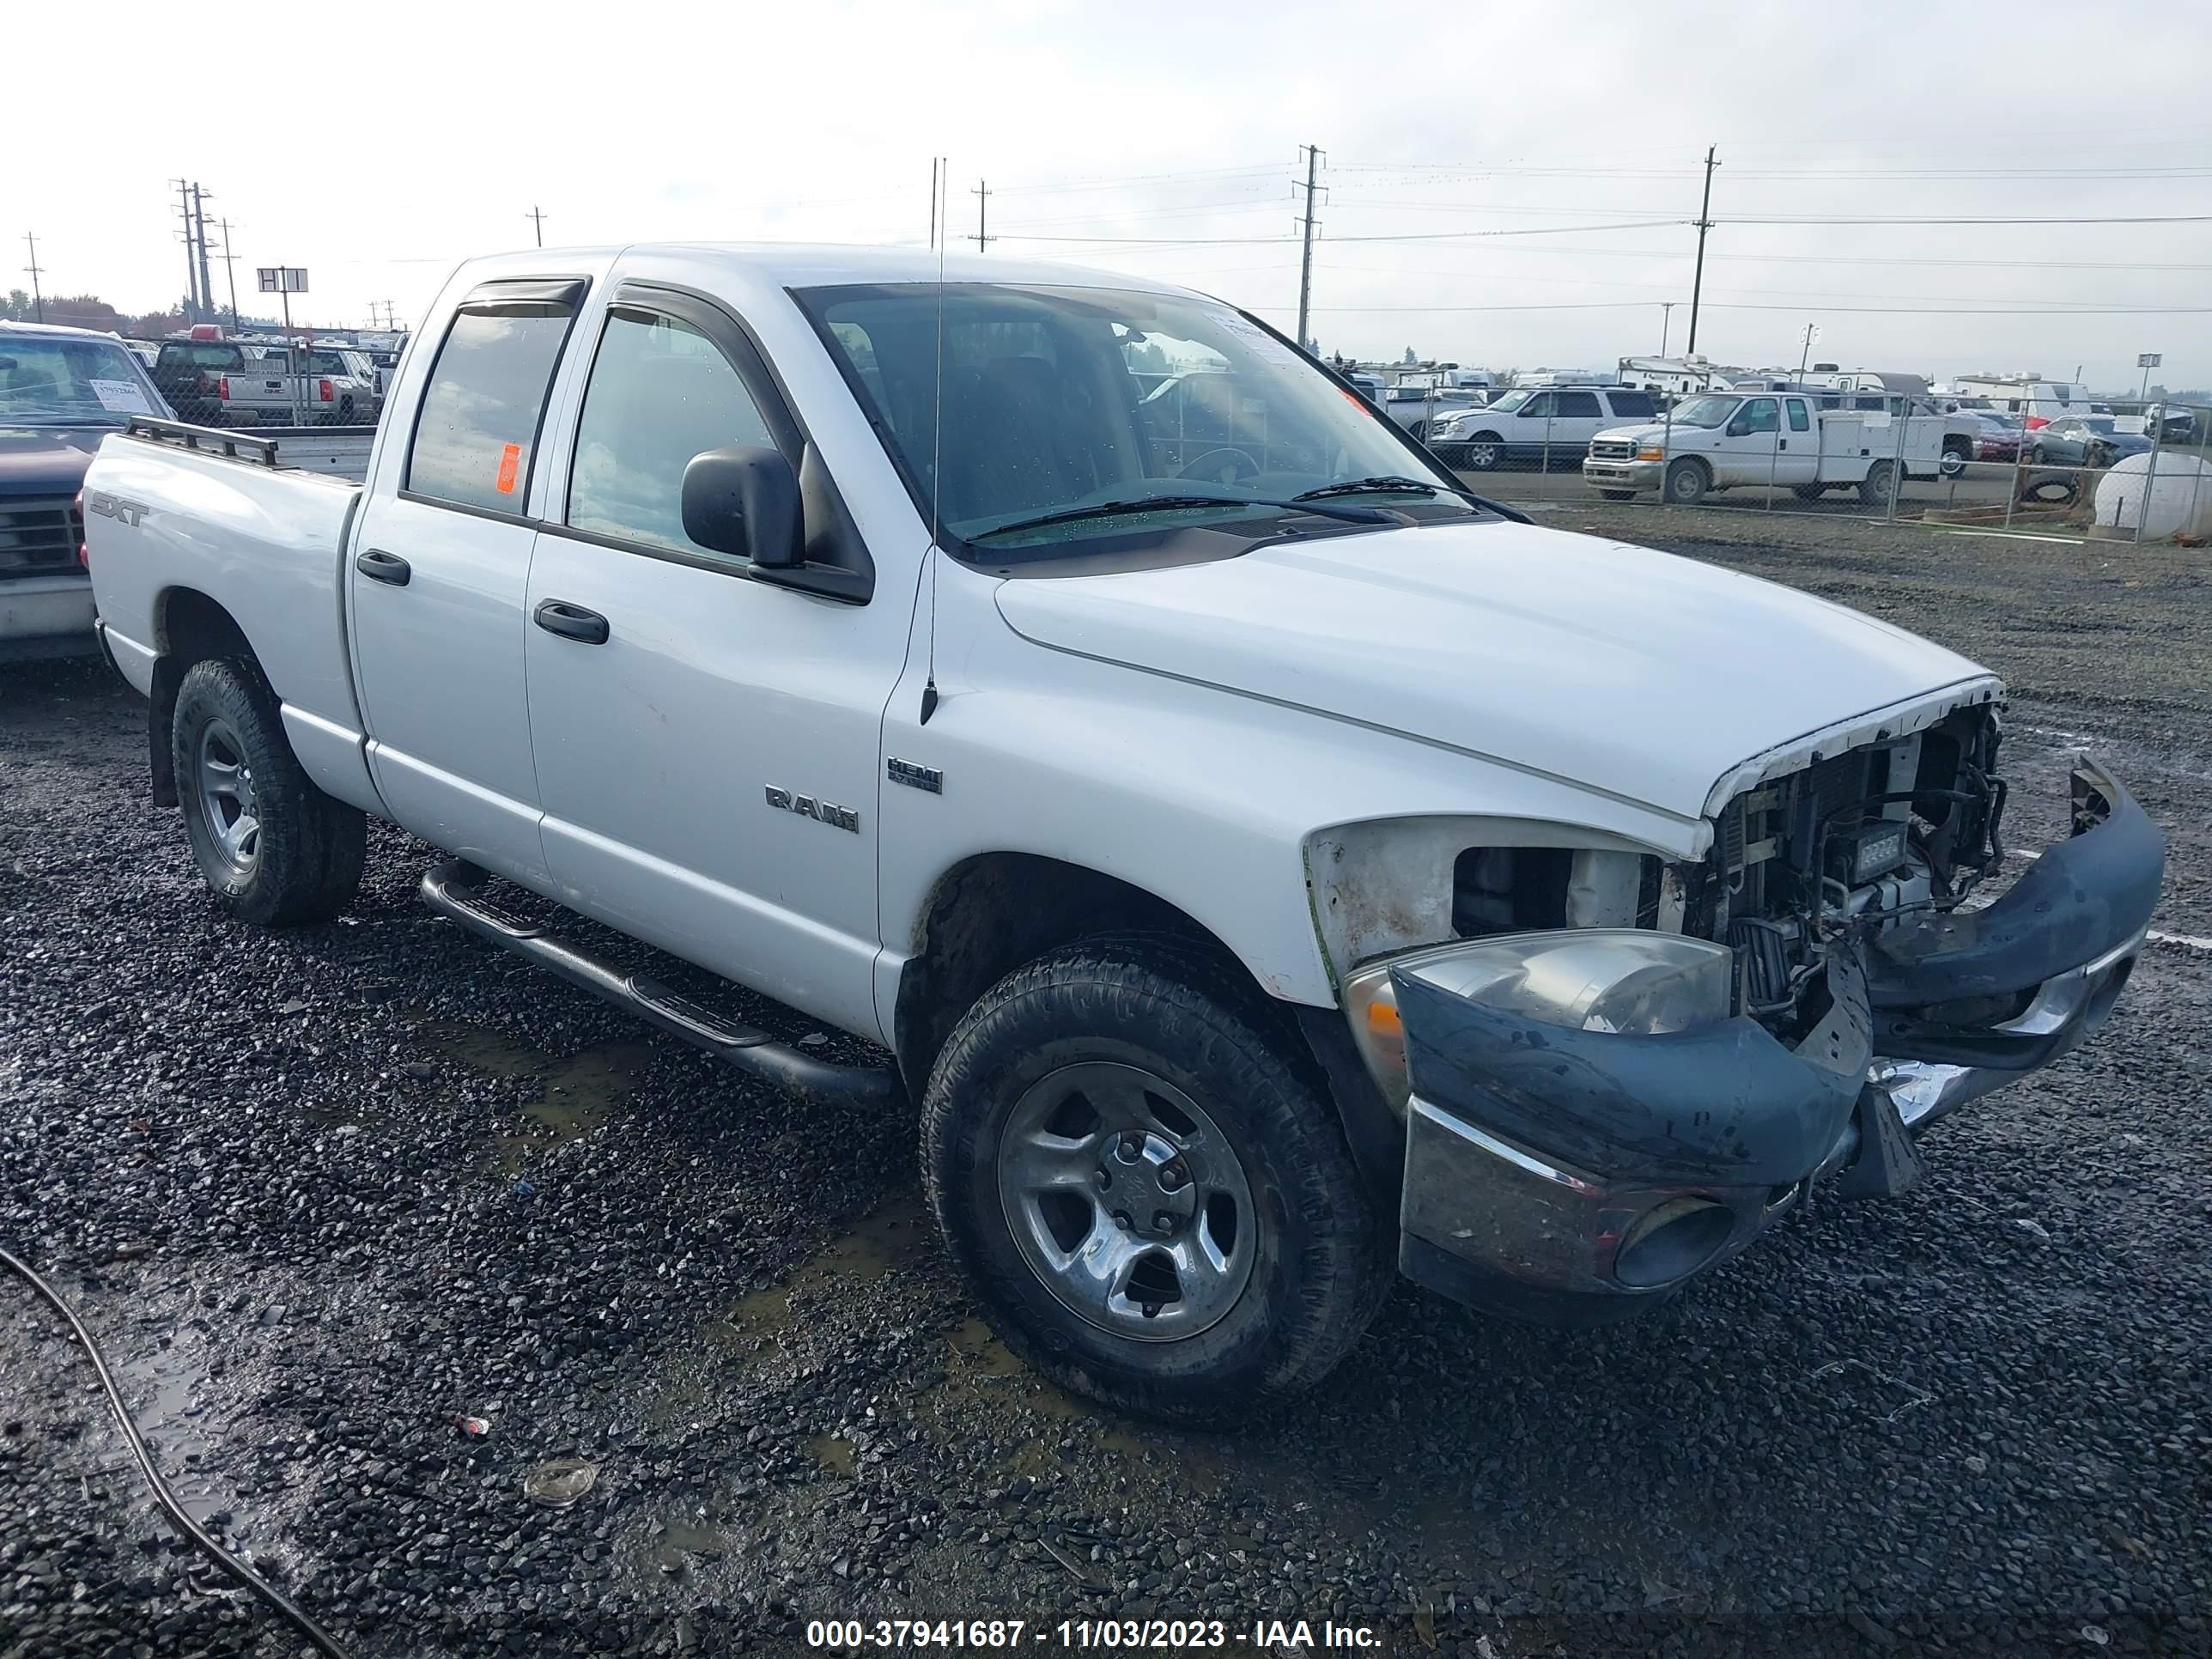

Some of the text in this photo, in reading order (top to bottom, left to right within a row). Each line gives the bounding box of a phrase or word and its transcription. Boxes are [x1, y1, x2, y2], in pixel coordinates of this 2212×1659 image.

[260, 269, 276, 291] H
[1813, 327, 1820, 343] F
[89, 492, 149, 528] SXT
[888, 756, 944, 784] HEMI
[765, 783, 859, 834] RAM
